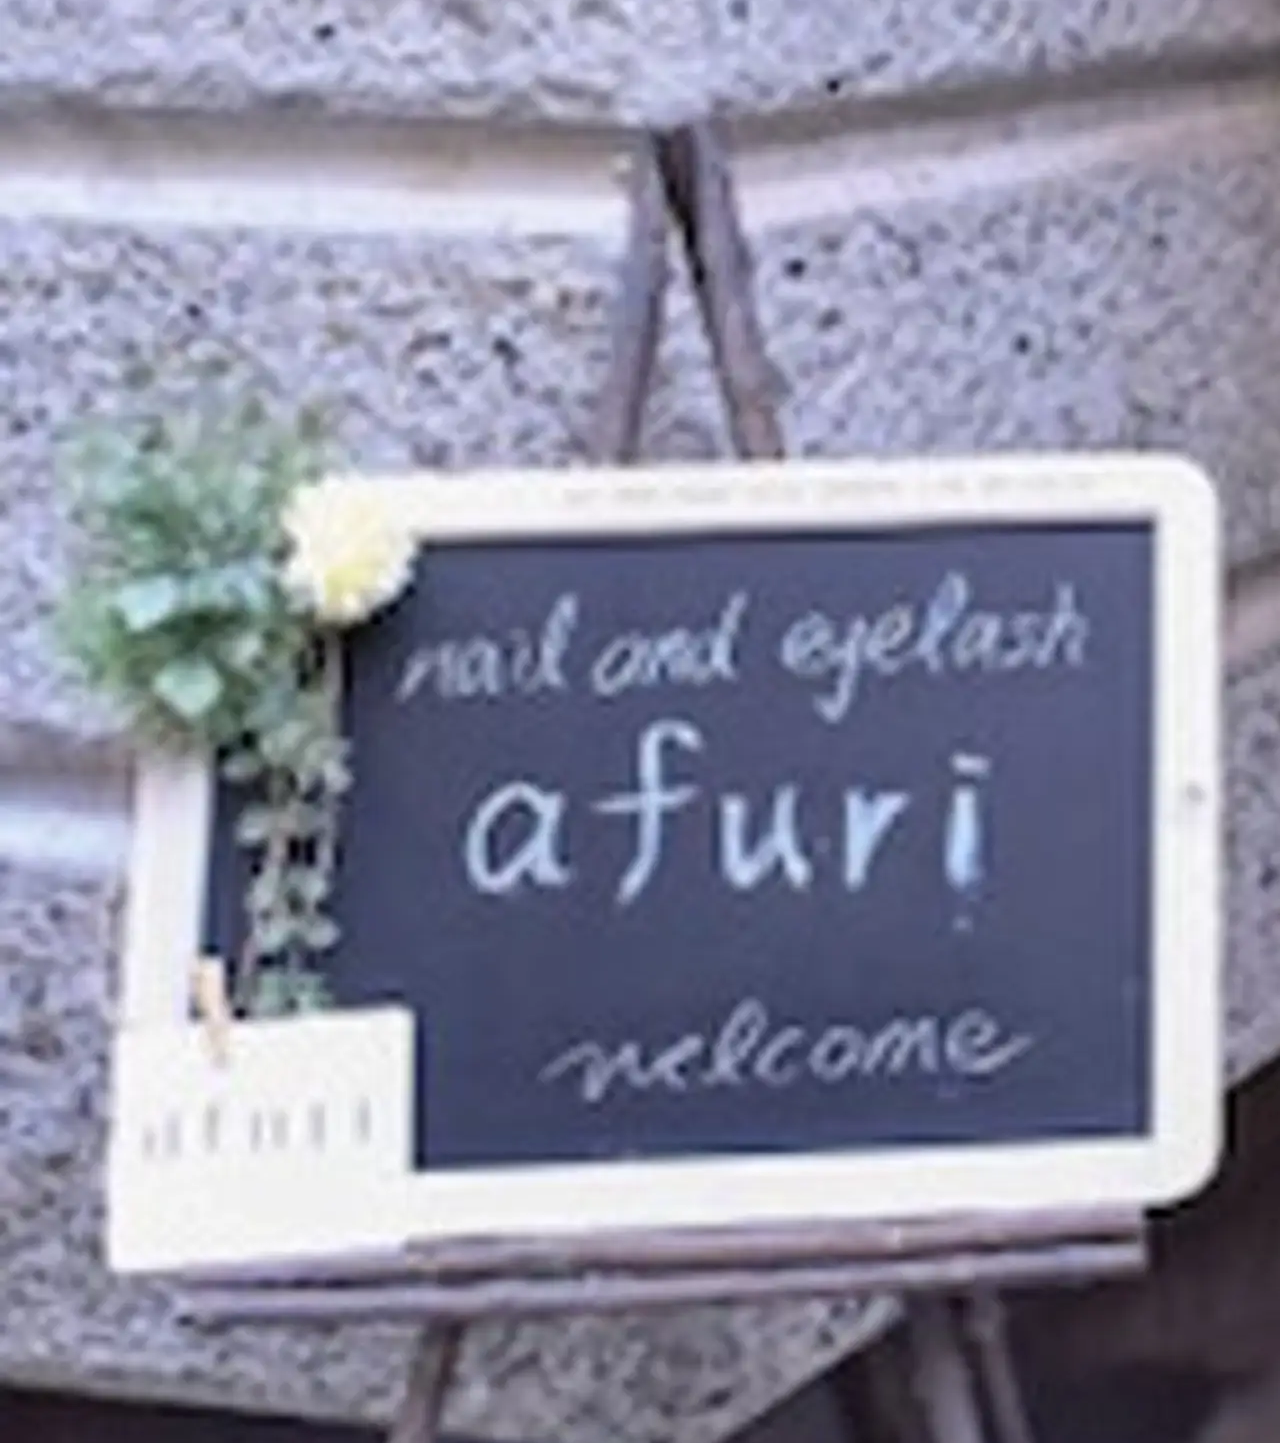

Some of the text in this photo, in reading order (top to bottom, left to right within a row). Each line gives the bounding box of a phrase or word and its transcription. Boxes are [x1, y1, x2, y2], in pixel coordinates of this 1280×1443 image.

[398, 570, 1093, 722] nail and eyelash
[464, 717, 993, 905] afuri
[537, 997, 1036, 1103] welcome
